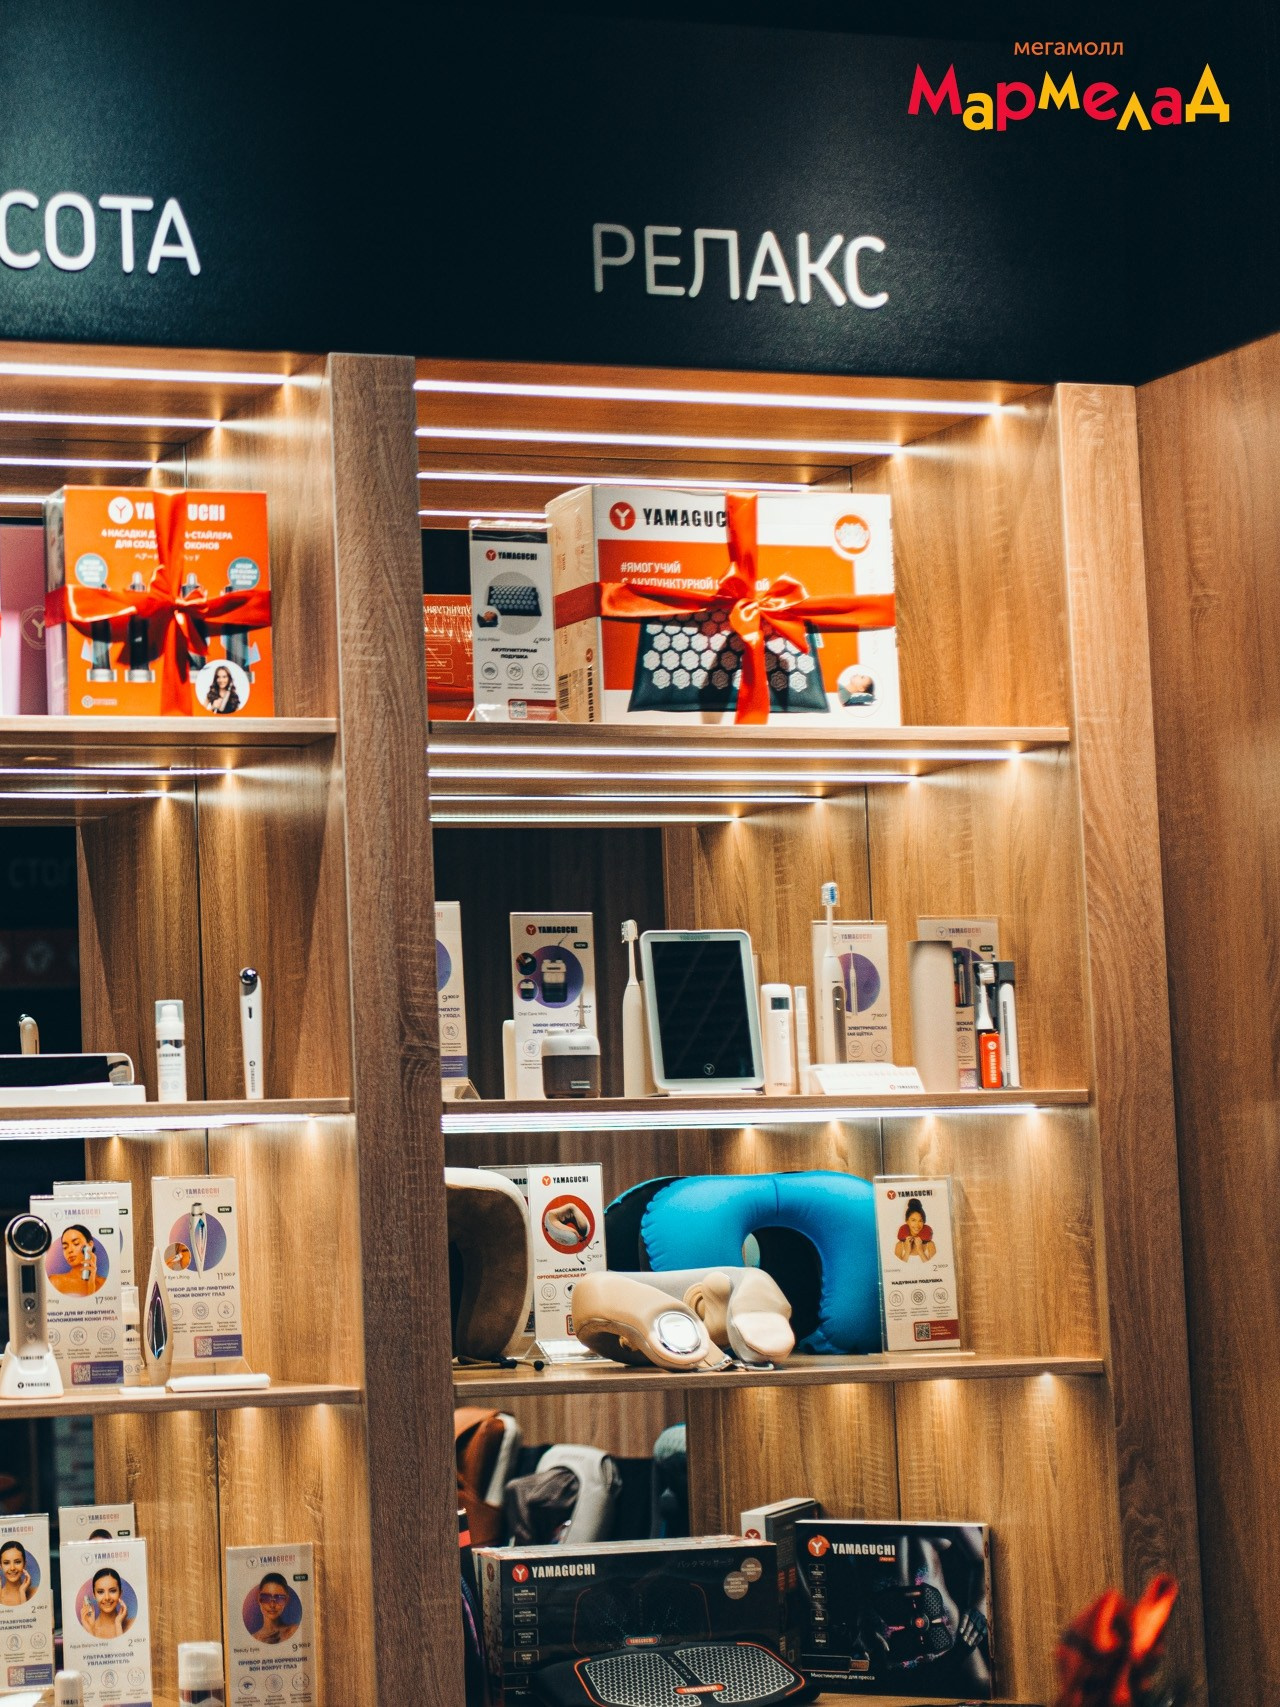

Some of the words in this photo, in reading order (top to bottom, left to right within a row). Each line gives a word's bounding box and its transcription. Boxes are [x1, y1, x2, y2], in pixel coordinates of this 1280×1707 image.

[589, 221, 891, 312] РЕЛАКС
[136, 502, 226, 522] YAUCHI
[497, 551, 538, 561] YAMAGUCHI
[620, 560, 681, 574] #ЯМОГУЧИЙ
[538, 926, 578, 934] YAMAGUCHI
[990, 1051, 998, 1084] YAMAGUCHI
[553, 1175, 589, 1184] YAMAGUCHI
[185, 1187, 220, 1195] YAMAGUCHI
[897, 1189, 933, 1198] YAMAGUCHI
[64, 1208, 101, 1216] YAMAGUCHI
[1, 1526, 34, 1534] YAMAGUCHI
[831, 1542, 896, 1556] YAMAGUCHI
[94, 1552, 130, 1560] YAMAGUCHI
[259, 1554, 296, 1564] YAMAGUCHI
[531, 1563, 596, 1579] YAMAGUCHI
[83, 1652, 135, 1660] УЛЬТРАЗВУКОВОЙ
[274, 1656, 308, 1664] КОРРЕКЦИИ
[810, 1672, 848, 1680] Миостимулятор
